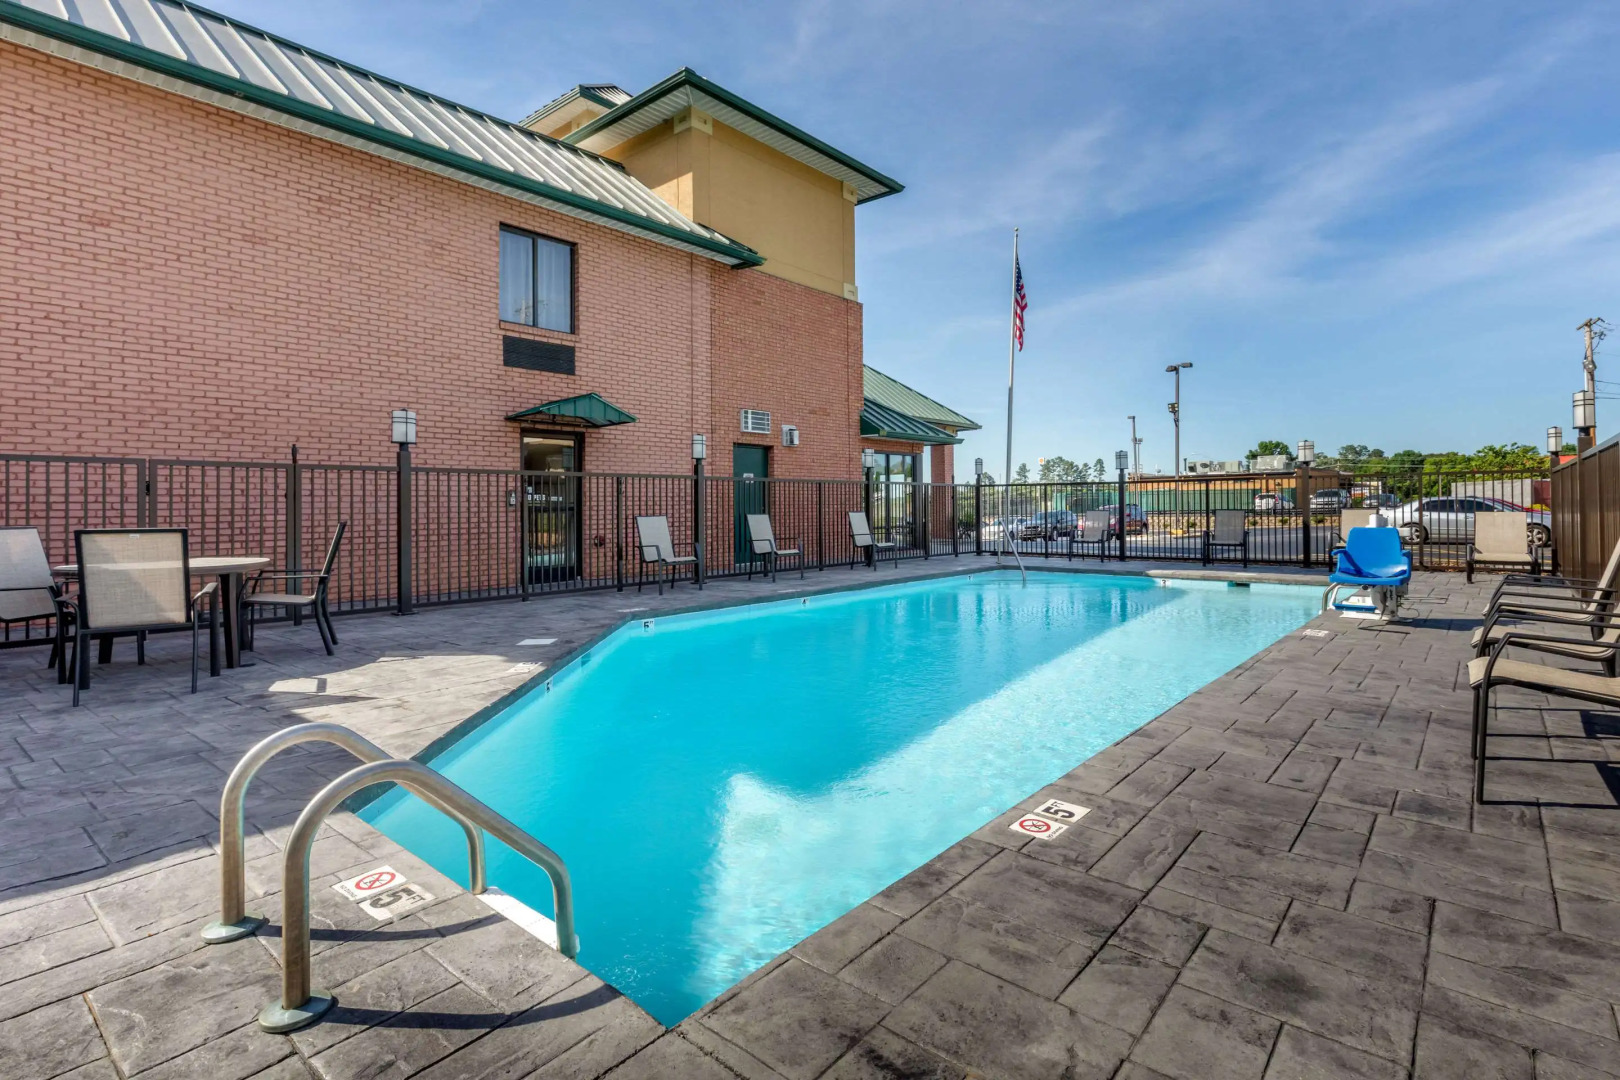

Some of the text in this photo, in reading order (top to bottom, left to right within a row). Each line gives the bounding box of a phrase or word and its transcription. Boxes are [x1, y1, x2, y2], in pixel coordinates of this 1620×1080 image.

[1041, 806, 1076, 819] 5
[369, 886, 417, 909] 5
[406, 894, 427, 904] FT
